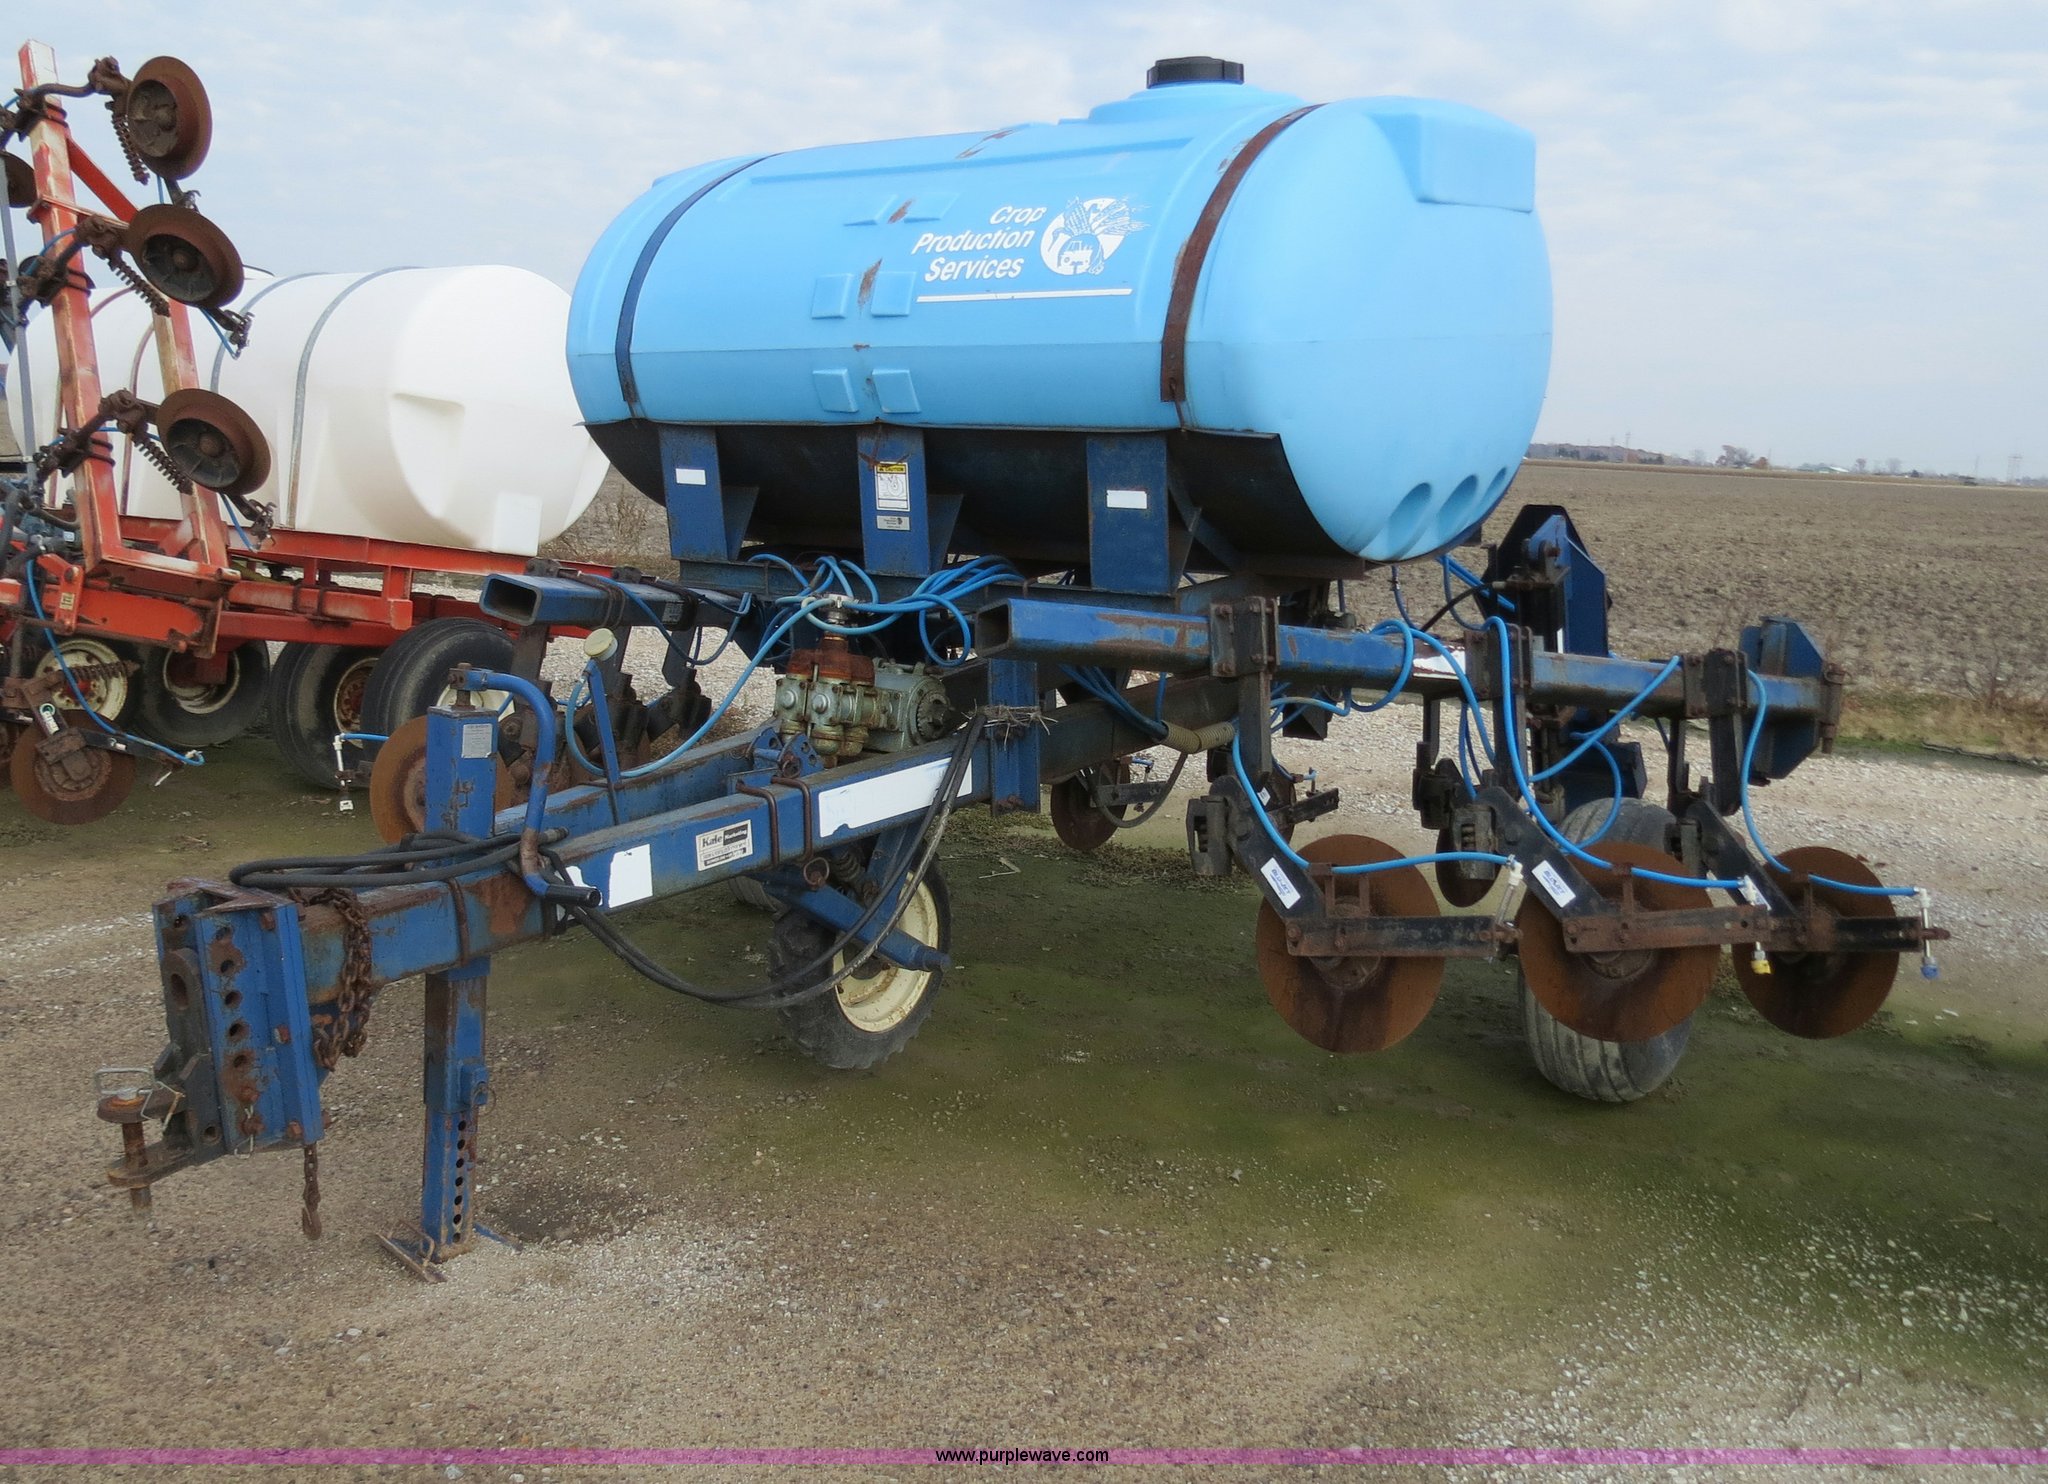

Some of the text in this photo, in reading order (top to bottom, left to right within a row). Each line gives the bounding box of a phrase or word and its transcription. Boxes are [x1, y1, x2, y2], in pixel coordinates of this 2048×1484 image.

[990, 206, 1047, 226] Crop
[911, 227, 1035, 255] Production
[924, 255, 1025, 282] Services
